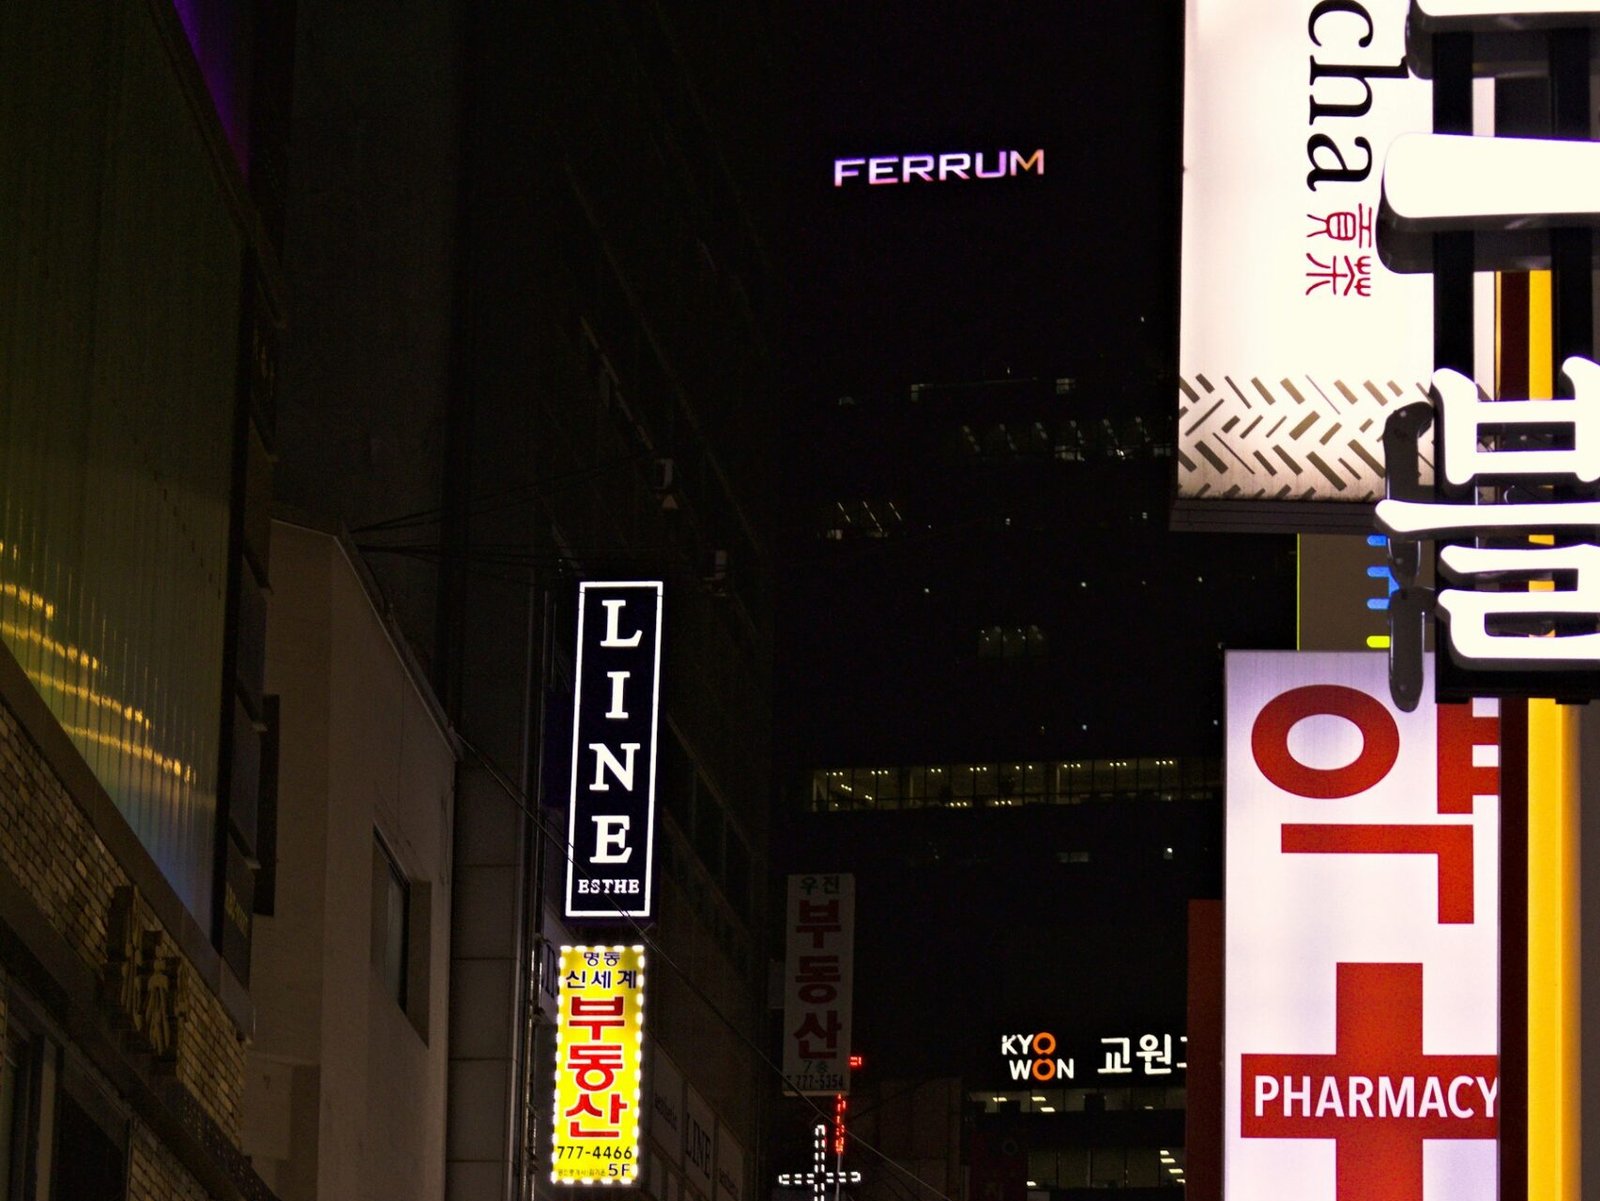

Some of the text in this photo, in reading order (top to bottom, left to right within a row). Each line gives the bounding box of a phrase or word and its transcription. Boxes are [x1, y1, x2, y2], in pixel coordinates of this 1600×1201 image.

[834, 149, 1045, 187] FERRUM
[588, 599, 643, 864] LINE
[577, 879, 640, 894] ESTHE
[583, 952, 621, 967] 명동
[566, 970, 637, 989] 신세계
[793, 900, 842, 1060] 부동산
[1002, 1032, 1056, 1056] KYO
[1097, 1033, 1188, 1075] 교원
[566, 996, 628, 1138] 부동산
[1009, 1058, 1074, 1081] WON
[1253, 1075, 1498, 1119] PHARMACY
[557, 1145, 633, 1161] 777-4466
[608, 1163, 631, 1177] 5F
